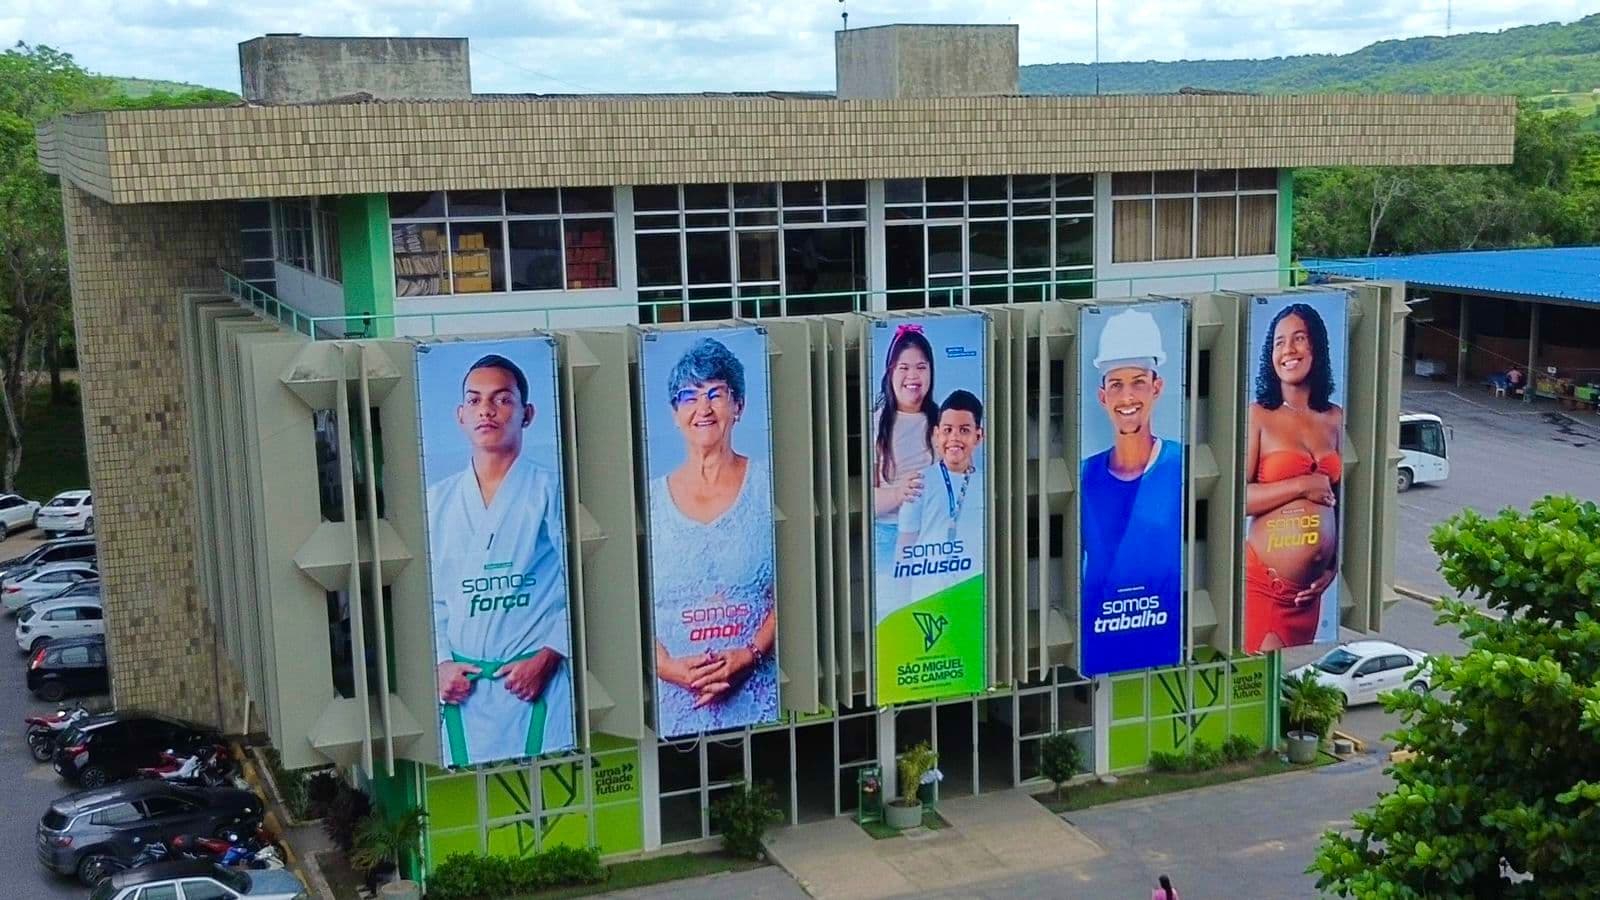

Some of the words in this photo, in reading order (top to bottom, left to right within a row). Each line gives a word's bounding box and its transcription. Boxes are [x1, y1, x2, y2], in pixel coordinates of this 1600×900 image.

[902, 540, 964, 559] somos
[893, 555, 972, 579] inclusão
[462, 572, 537, 594] somos
[469, 592, 531, 618] força
[681, 603, 750, 625] somos
[1102, 595, 1160, 615] somos
[1094, 609, 1168, 633] trabalho
[922, 658, 964, 673] MIGUEL
[897, 674, 919, 686] DOS
[920, 668, 964, 682] CAMPOS
